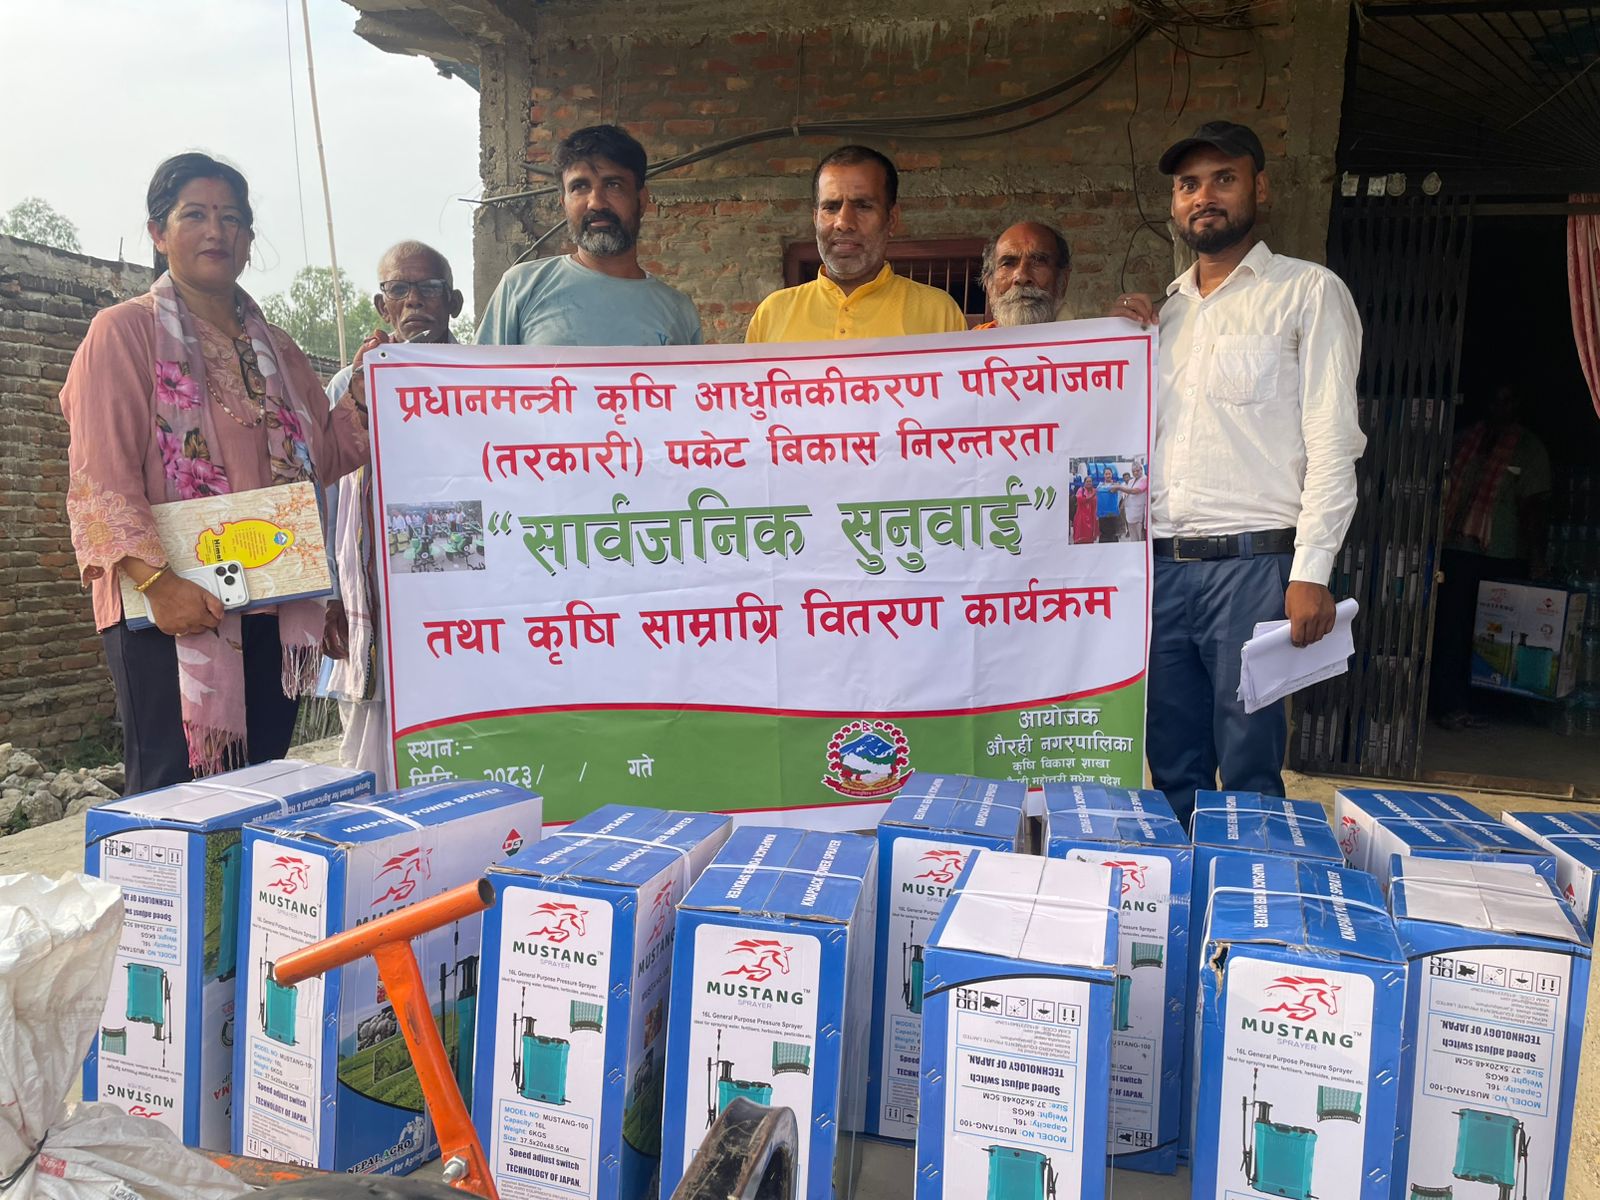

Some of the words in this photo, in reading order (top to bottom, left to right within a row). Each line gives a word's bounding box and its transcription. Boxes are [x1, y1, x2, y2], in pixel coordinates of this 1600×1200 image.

[395, 375, 577, 422] प्रधानमन्त्री
[594, 372, 677, 425] कृषि
[695, 366, 943, 421] आधुनिकीकरण
[959, 355, 1130, 401] परियोजना
[482, 430, 643, 481] (तरकारी)
[664, 431, 750, 468] पकेट
[766, 424, 881, 466] बिकास
[896, 417, 1060, 464] निरन्तरता
[422, 617, 506, 659] तथा
[524, 600, 620, 665] कृषि
[639, 592, 783, 649] साम्राग्रि
[801, 589, 945, 639] वितरण
[961, 578, 1118, 627] कार्यक्रम
[1019, 705, 1101, 729] आयोजक
[986, 734, 1033, 756] औरही
[1041, 730, 1133, 753] नगरपालिका
[627, 754, 654, 777] गते
[1012, 759, 1036, 774] कृषि
[1081, 758, 1110, 769] शाखा
[302, 791, 331, 811] Agricultural
[331, 793, 339, 801] for
[411, 799, 455, 817] POWER
[454, 787, 504, 806] SPRAYER
[902, 882, 953, 898] MUSTA
[138, 895, 173, 907] TECHNOLOGY
[259, 890, 318, 918] MUSTANG
[133, 910, 152, 918] adjust
[153, 912, 171, 921] Speed
[118, 945, 145, 954] MUSTANG
[512, 941, 598, 966] MUSTANG
[540, 958, 570, 969] SPRAYER
[518, 970, 536, 979] General
[536, 973, 555, 983] Purpose
[556, 978, 577, 987] Pressure
[578, 981, 597, 990] Sprayer
[706, 981, 804, 1005] MUSTANG
[738, 999, 772, 1009] SPRAYER
[712, 1012, 733, 1021] General
[733, 1015, 756, 1024] Purpose
[756, 1018, 780, 1027] Pressure
[781, 1022, 803, 1030] Sprayer
[1440, 1020, 1469, 1032] JAPAN.
[1241, 1017, 1353, 1049] MUSTANG
[1470, 1025, 1482, 1035] OF
[1483, 1027, 1541, 1045] TECHNOLOGY
[1277, 1037, 1317, 1051] SPRAYER
[1442, 1038, 1473, 1051] switch
[1475, 1044, 1505, 1055] adjust
[968, 1055, 995, 1068] JAPAN.
[1236, 1047, 1246, 1056] 16L
[1248, 1049, 1271, 1060] General
[1272, 1054, 1298, 1065] Purpose
[1299, 1059, 1326, 1071] Pressure
[1328, 1065, 1353, 1075] Sprayer
[1506, 1049, 1536, 1062] Speed
[996, 1060, 1007, 1069] OF
[1009, 1062, 1064, 1078] TECHNOLOGY
[1455, 1057, 1520, 1074] 37.5x20x48.5CM
[1485, 1072, 1509, 1082] 6KGS
[1523, 1068, 1544, 1077] Size:
[970, 1074, 999, 1086] switch
[1001, 1078, 1030, 1089] adjust
[1486, 1083, 1500, 1091] 16L
[1511, 1077, 1543, 1088] Weight:
[107, 1084, 173, 1108] MUSTANG
[257, 1082, 273, 1096] Speed
[273, 1088, 289, 1101] adjust
[289, 1095, 307, 1107] switch
[1031, 1083, 1060, 1096] Speed
[1429, 1083, 1490, 1099] MUSTANG-100
[1503, 1085, 1542, 1098] Capacity:
[254, 1095, 285, 1116] TECHNOLOGY
[284, 1108, 291, 1117] OF
[982, 1092, 1046, 1108] 37.5x20x48.5CM
[1492, 1095, 1508, 1104] NO:
[1510, 1097, 1541, 1108] MODEL
[1012, 1107, 1035, 1117] 6KGS
[1049, 1103, 1068, 1112] Size:
[503, 1116, 532, 1128] Capacity:
[504, 1106, 528, 1117] MODEL
[542, 1114, 589, 1130] MUSTANG-100
[1013, 1118, 1027, 1126] 16L
[1038, 1112, 1068, 1122] Weight:
[503, 1125, 527, 1135] Weight:
[528, 1129, 547, 1139] 6KGS
[959, 1119, 1017, 1135] MUSTANG-100
[1030, 1120, 1068, 1132] Capacity:
[503, 1134, 518, 1142] Size:
[520, 1136, 570, 1153] 37.5x20x48.5CM
[1037, 1132, 1067, 1143] MODEL
[346, 1153, 382, 1174] NEPAL
[383, 1138, 412, 1159] AGRO
[509, 1148, 532, 1160] Speed
[532, 1152, 555, 1165] adjust
[556, 1158, 580, 1170] switch
[505, 1163, 549, 1179] TECHNOLOGY
[550, 1171, 558, 1181] OF
[559, 1174, 582, 1187] JAPAN.
